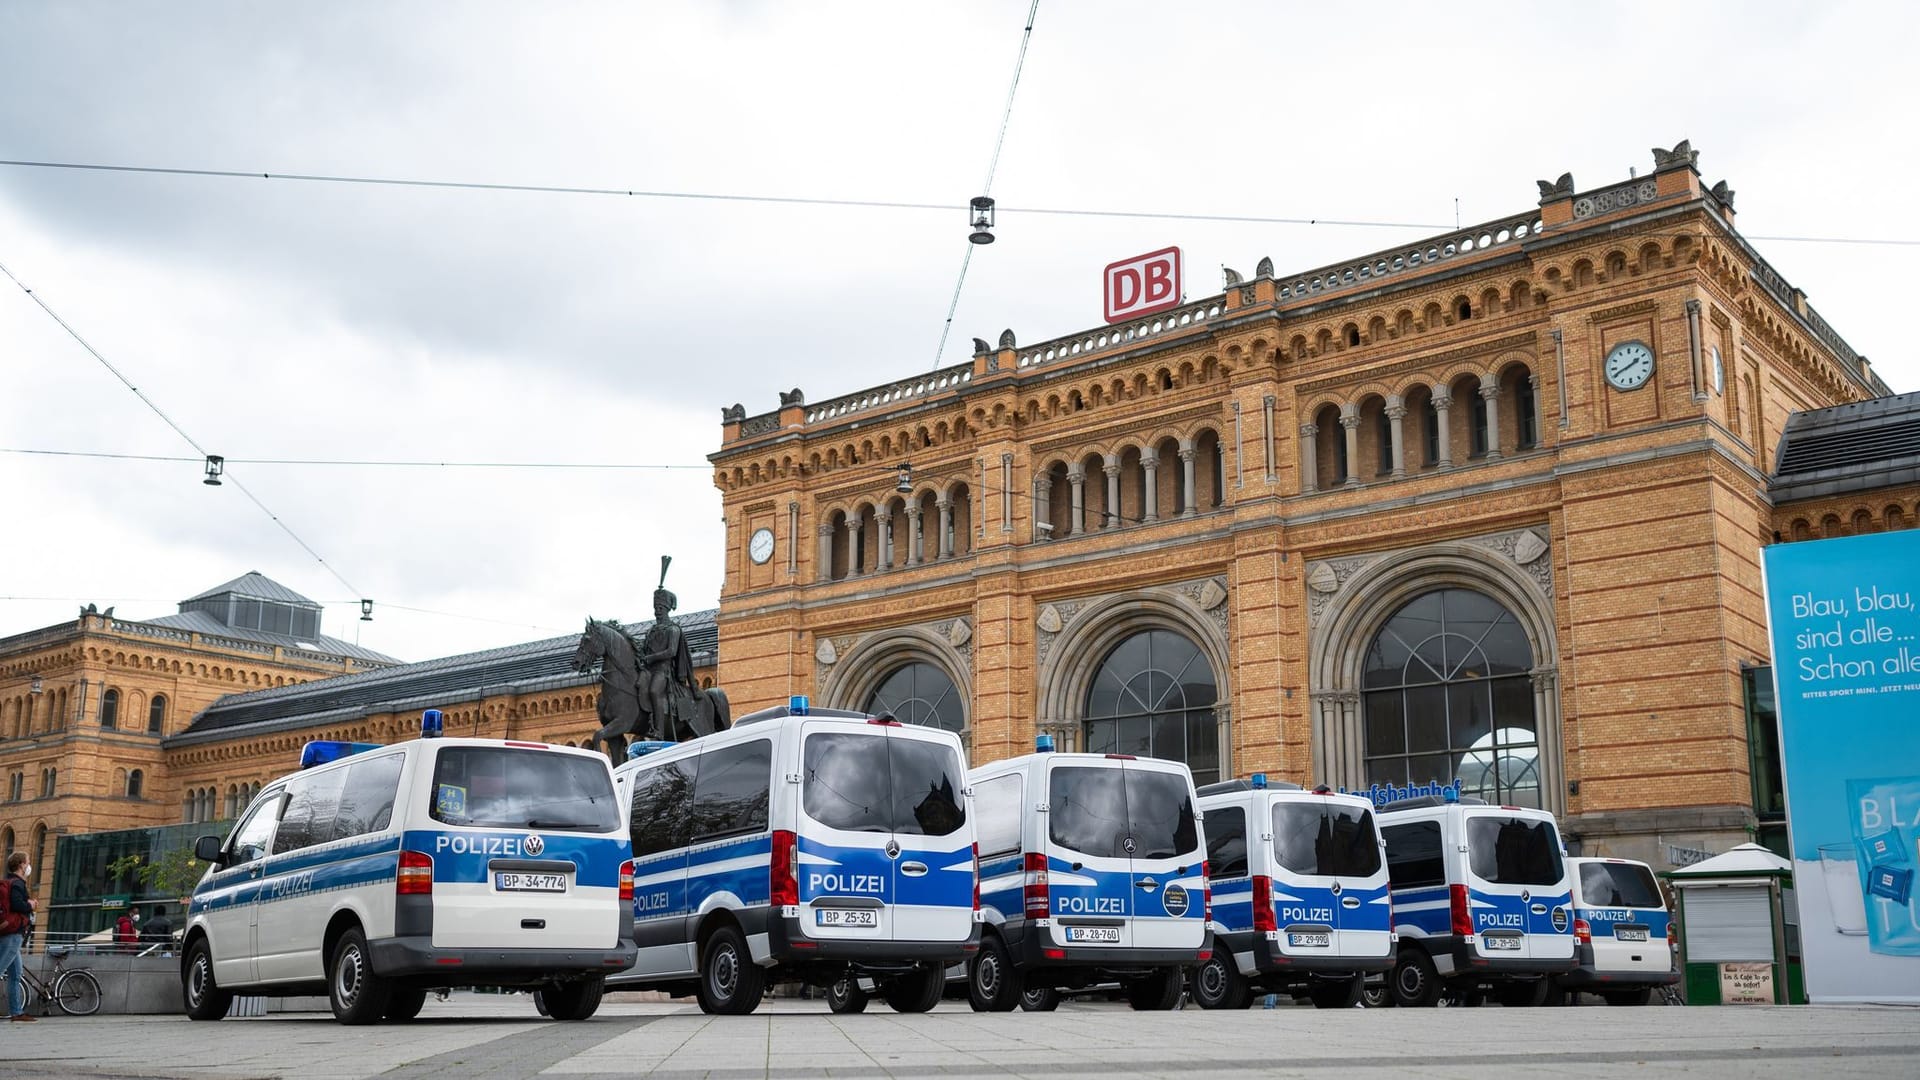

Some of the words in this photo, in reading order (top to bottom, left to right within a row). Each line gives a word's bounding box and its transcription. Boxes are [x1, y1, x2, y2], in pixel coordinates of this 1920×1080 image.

[1113, 259, 1172, 311] DB
[1792, 592, 1848, 618] Blau,
[1856, 585, 1915, 612] blau,
[1796, 620, 1842, 649] sind
[1800, 653, 1875, 681] Schon
[1802, 691, 1827, 699] RITTER
[1829, 688, 1854, 697] SPORT
[1880, 684, 1902, 693] JETZT
[447, 789, 456, 798] H
[439, 800, 460, 811] 213
[436, 836, 521, 856] POLIZEI
[271, 871, 314, 898] POLIZEI
[503, 874, 519, 888] BP
[525, 875, 564, 889] 34-774
[809, 873, 884, 893] POLIZEI
[633, 891, 669, 911] POLIZEI
[1058, 897, 1125, 913] POLIZEI
[826, 911, 839, 923] BP
[844, 912, 872, 924] 25-32
[1282, 907, 1333, 922] POLIZEI
[1479, 913, 1523, 926] POLIZEI
[1588, 911, 1627, 921] POLIZEI
[1074, 929, 1085, 939] BP
[1293, 935, 1303, 944] BP
